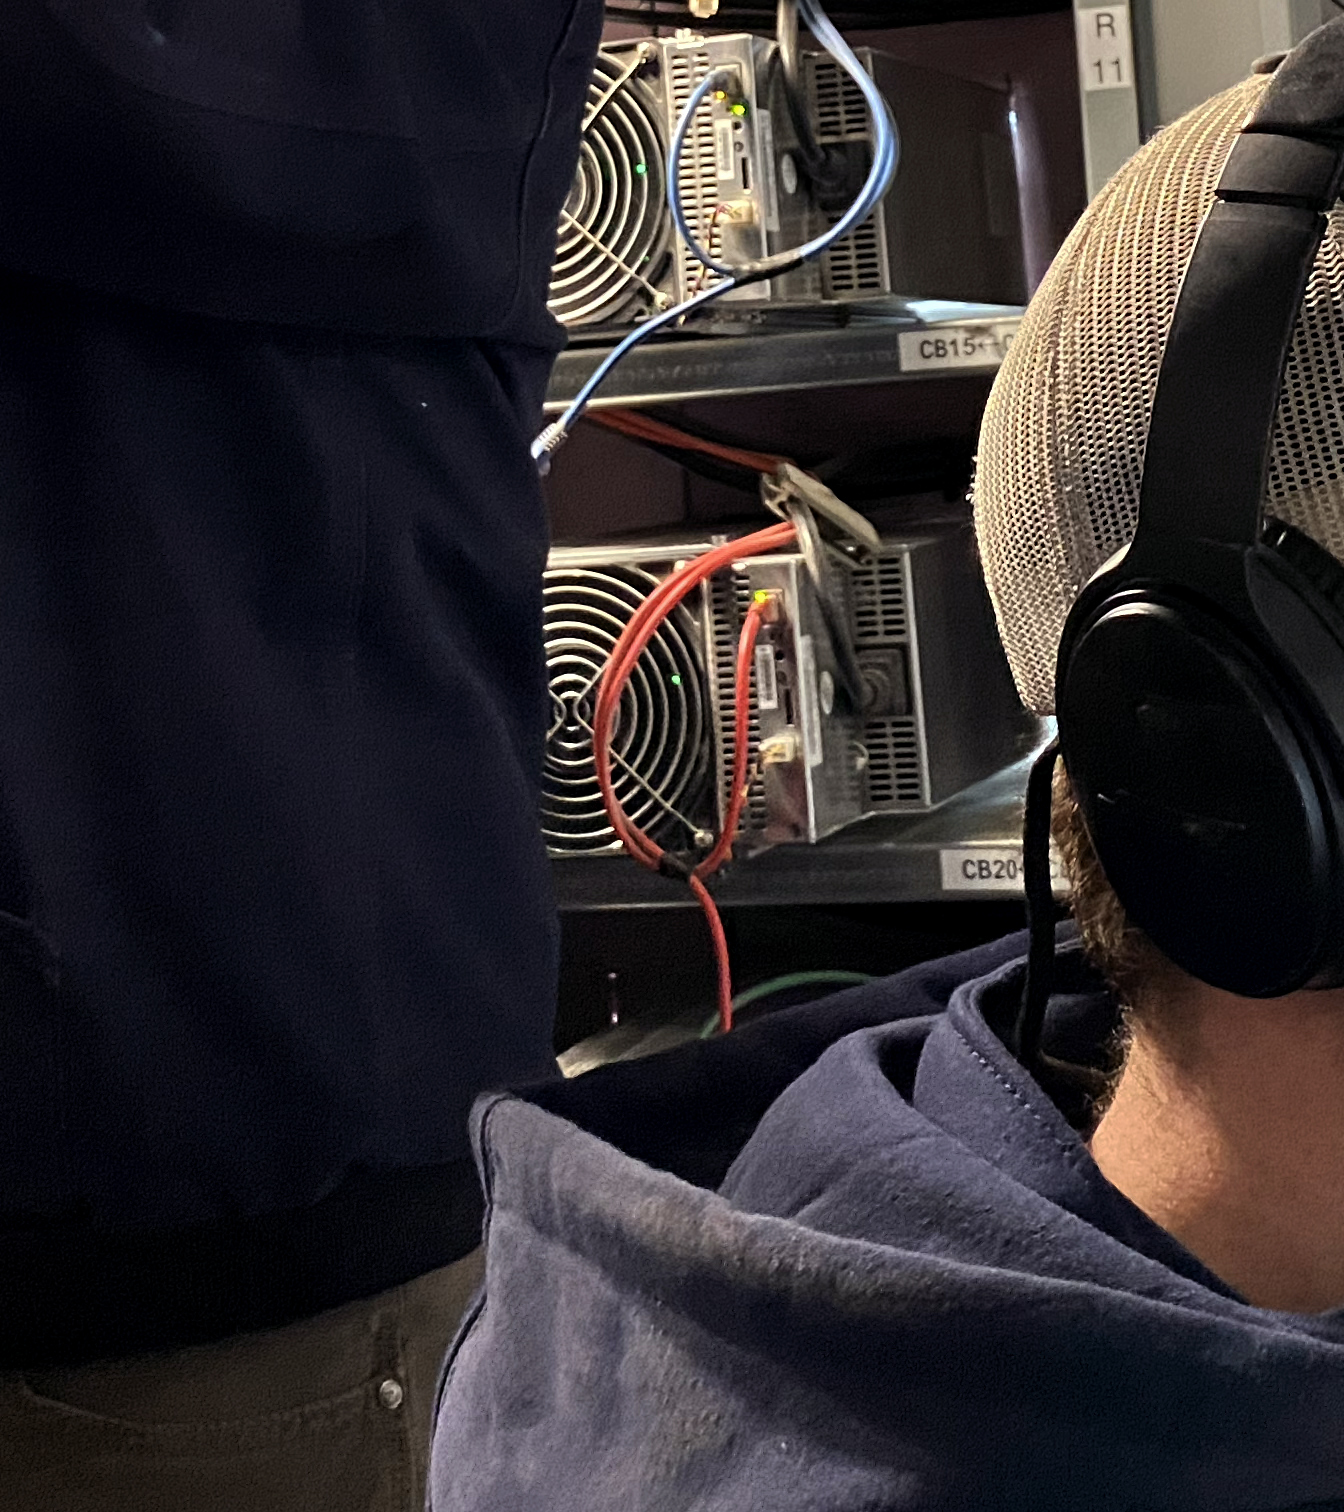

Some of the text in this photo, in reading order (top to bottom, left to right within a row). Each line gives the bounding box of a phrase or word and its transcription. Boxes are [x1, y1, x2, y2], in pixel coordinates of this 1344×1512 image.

[1095, 12, 1116, 39] R
[1092, 56, 1122, 85] 11
[919, 337, 977, 360] CB15
[961, 858, 1018, 880] CB20
